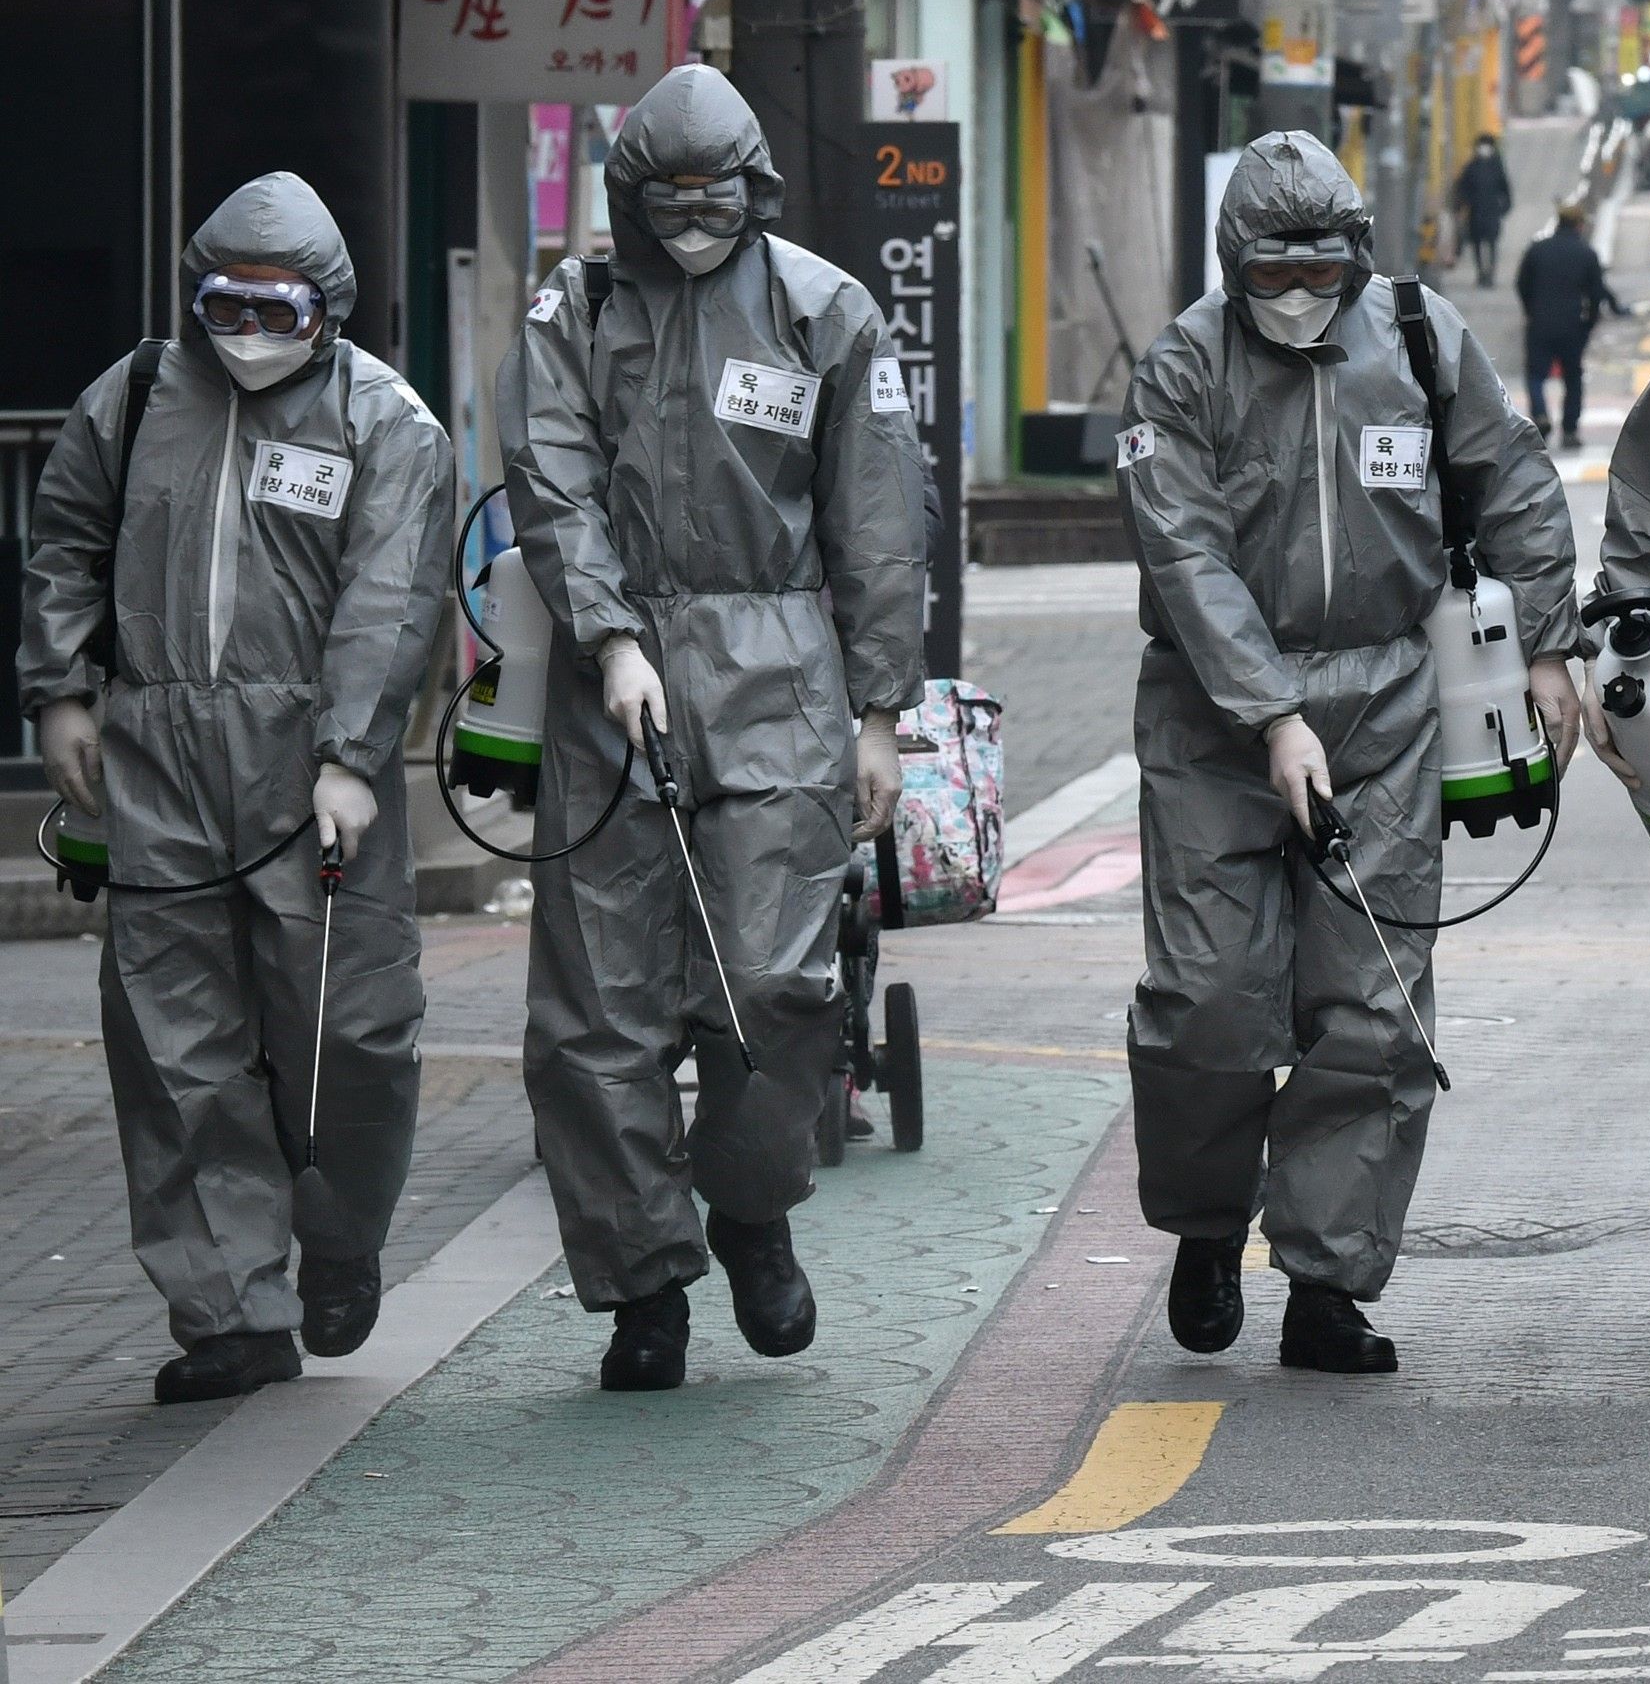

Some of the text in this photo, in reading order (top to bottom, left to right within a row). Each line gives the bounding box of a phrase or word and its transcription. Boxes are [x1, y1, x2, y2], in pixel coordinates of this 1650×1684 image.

[875, 145, 946, 187] 2ND
[738, 372, 759, 394] 육
[726, 394, 803, 425] 현장 지원팀
[1376, 436, 1394, 456] 육
[268, 452, 286, 473] 육
[1370, 461, 1398, 477] 현장
[258, 474, 333, 506] 현장 지원팀
